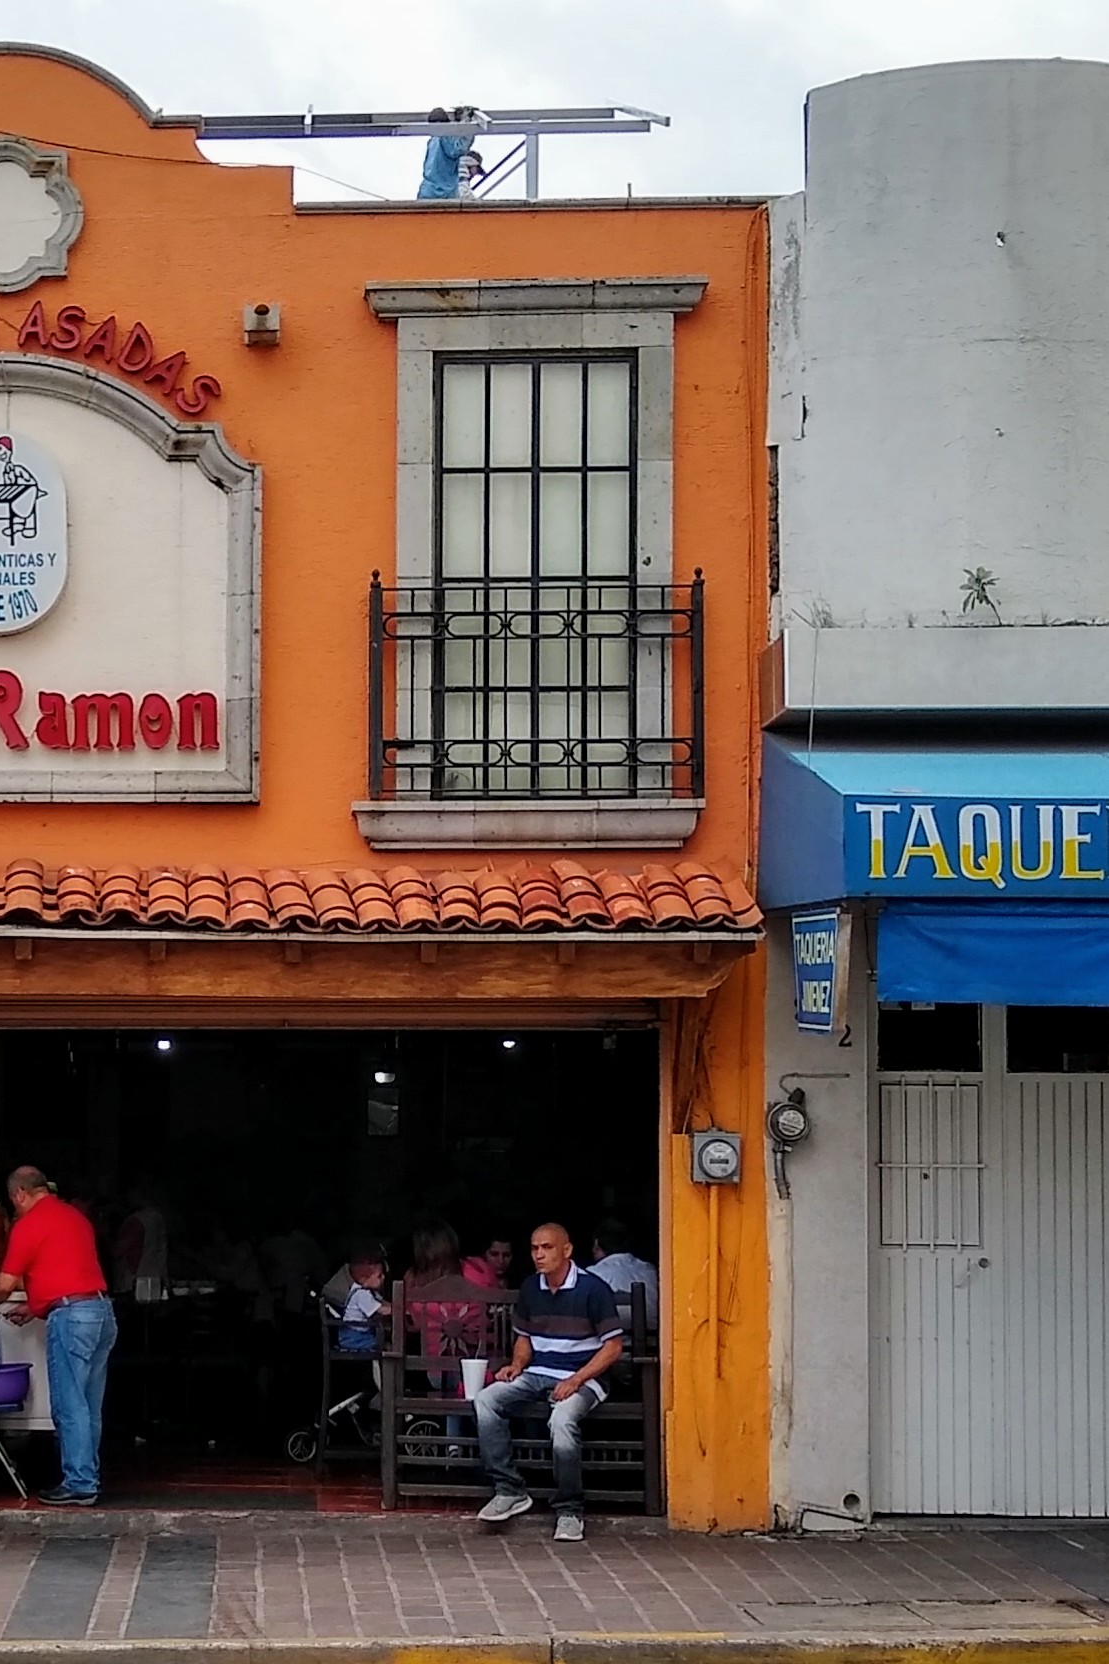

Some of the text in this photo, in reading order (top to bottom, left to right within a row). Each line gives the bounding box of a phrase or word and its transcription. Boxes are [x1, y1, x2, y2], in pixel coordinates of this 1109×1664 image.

[18, 300, 222, 413] ASADAS
[48, 552, 57, 567] Y
[7, 588, 38, 620] 1970
[855, 802, 1109, 889] TAQUE
[795, 930, 835, 966] TAQUERIA
[838, 1024, 852, 1047] 2
